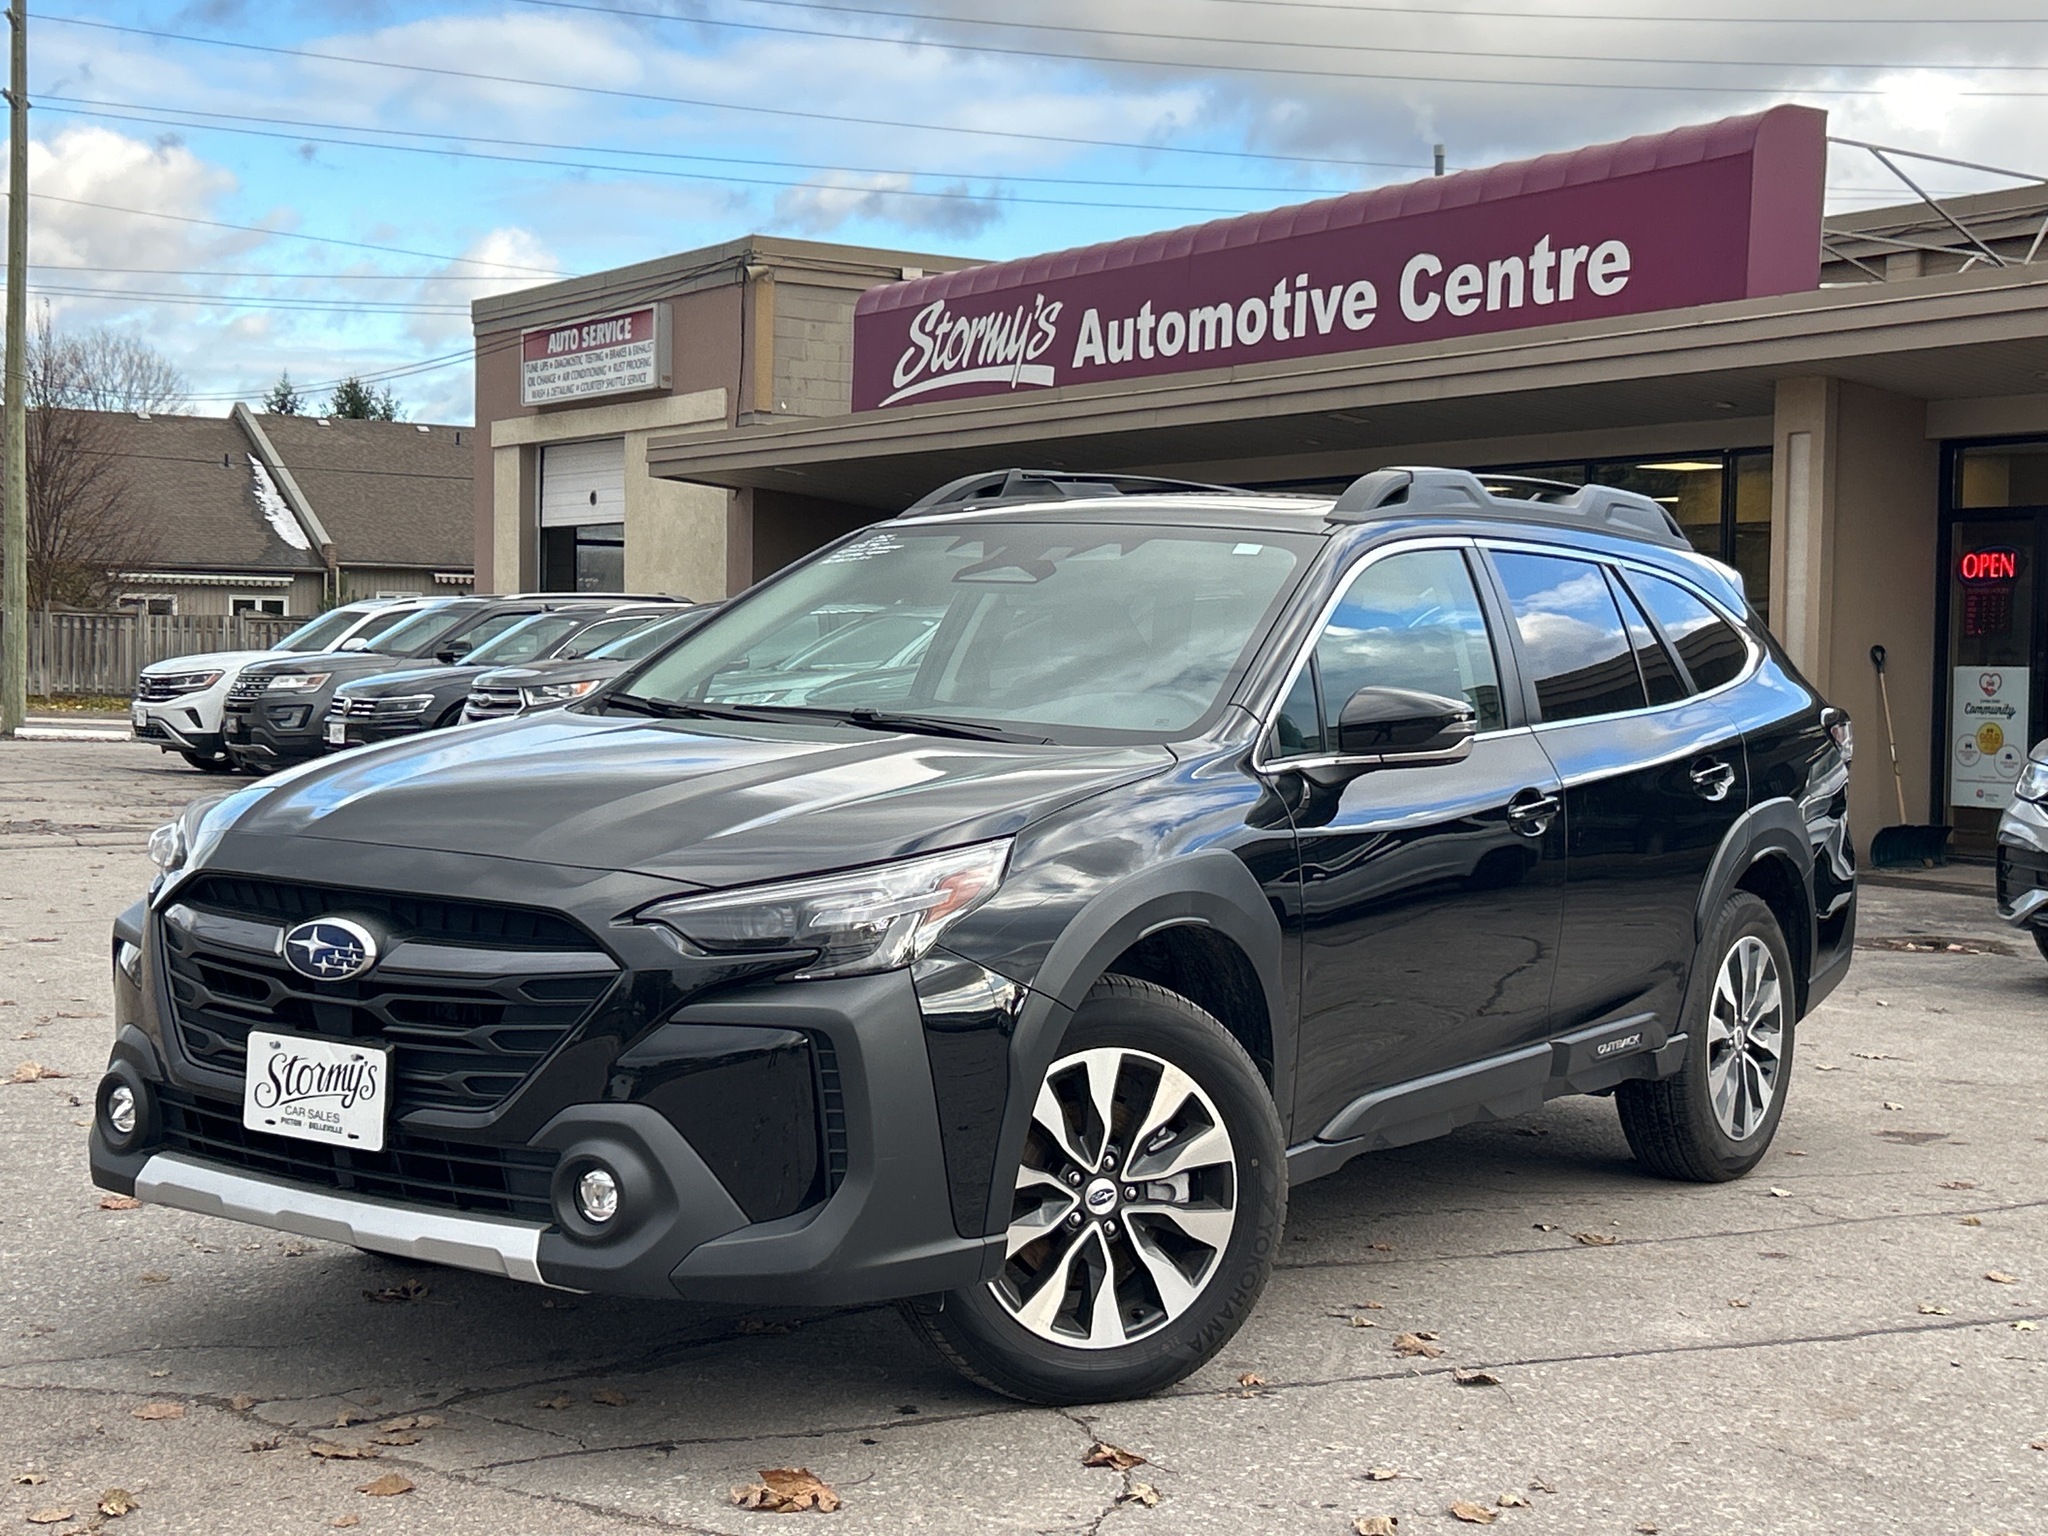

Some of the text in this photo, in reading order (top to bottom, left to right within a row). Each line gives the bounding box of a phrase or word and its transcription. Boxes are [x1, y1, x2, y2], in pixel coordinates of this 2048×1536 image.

[892, 233, 1632, 390] Stormy's Automotive Centre
[547, 317, 632, 354] AUTO SERVICE
[585, 351, 604, 364] TESTING
[536, 373, 556, 386] CHANGE
[562, 371, 570, 382] AIR
[571, 364, 607, 380] CONDITIONING
[550, 383, 575, 397] DETAILING
[627, 372, 647, 386] SERVICE
[1962, 552, 2015, 579] OPEN
[1964, 702, 2016, 720] Community
[1597, 1033, 1641, 1055] OUTBACK
[254, 1052, 378, 1109] Stormy's
[280, 1116, 343, 1135] PICTON BELLEVILLE
[284, 1105, 341, 1124] CAR SALES
[1187, 1223, 1274, 1354] YOKOHAMA
